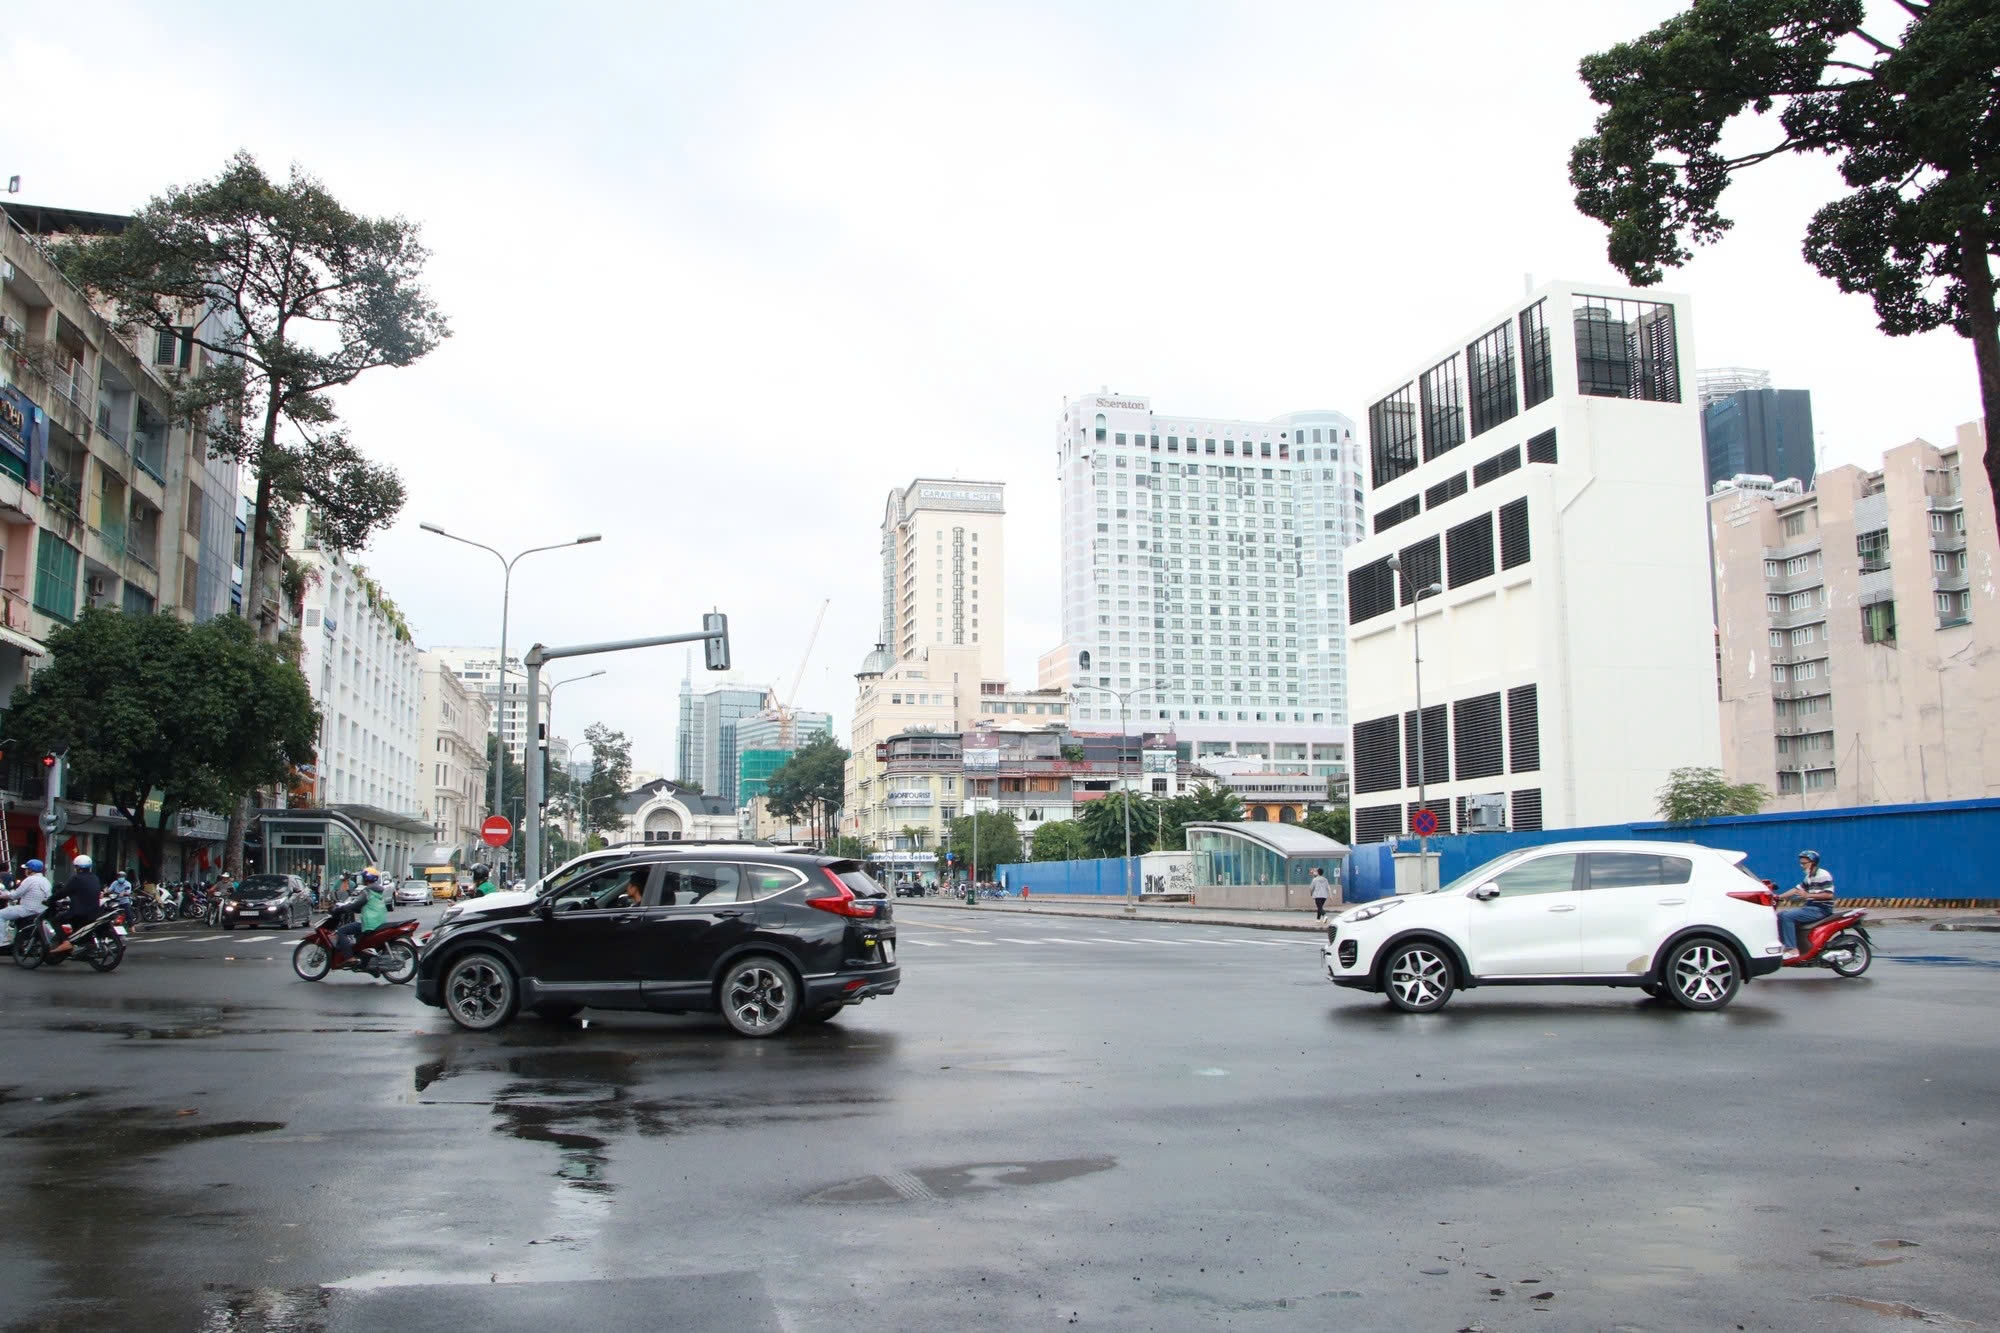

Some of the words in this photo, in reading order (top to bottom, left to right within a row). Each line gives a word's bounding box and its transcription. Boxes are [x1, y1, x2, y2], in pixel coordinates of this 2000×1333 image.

[1096, 398, 1145, 410] Sheraton
[923, 489, 970, 500] CARAVELLE
[973, 492, 1000, 501] HOTEL
